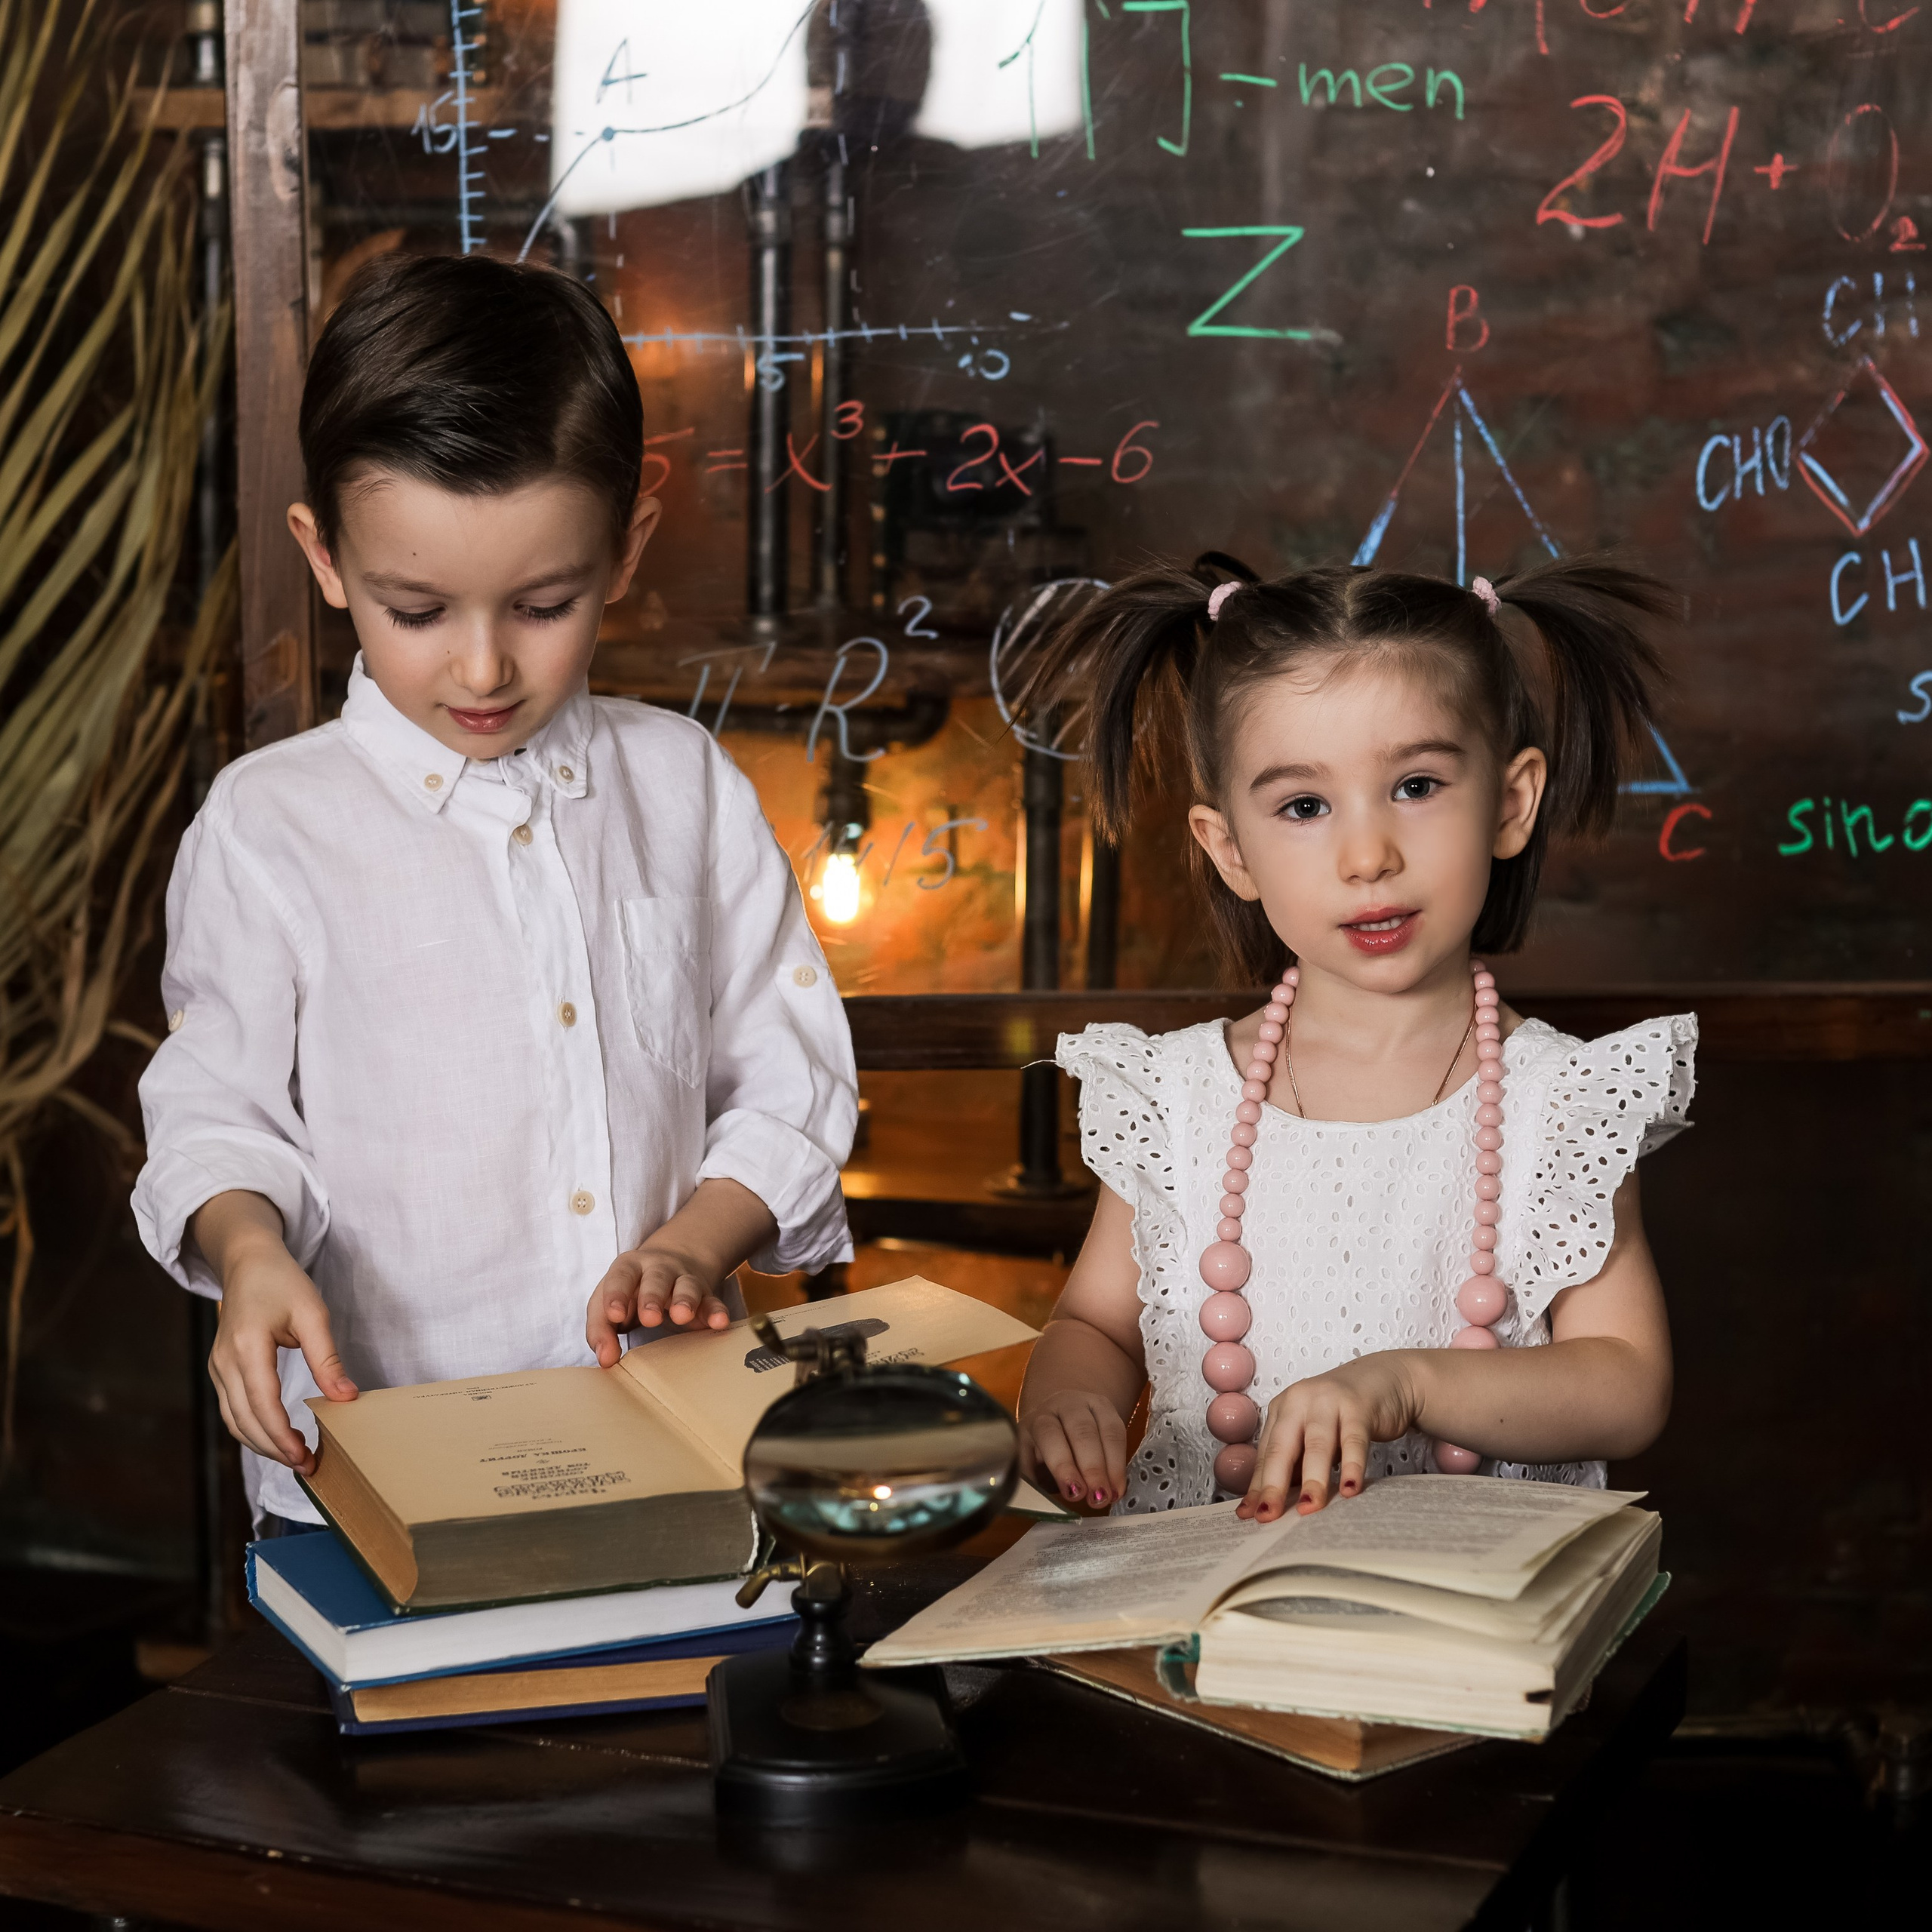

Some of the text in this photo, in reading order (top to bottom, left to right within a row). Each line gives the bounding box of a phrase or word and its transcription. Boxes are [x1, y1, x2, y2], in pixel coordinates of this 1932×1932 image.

[595, 38, 648, 105] A
[1298, 63, 1466, 121] men
[411, 91, 459, 154] 15
[1181, 225, 1314, 341] Z
[1447, 284, 1491, 353] B
[1697, 414, 1794, 512] CHO
[1829, 537, 1927, 627] CH
[1660, 802, 1712, 862] C
